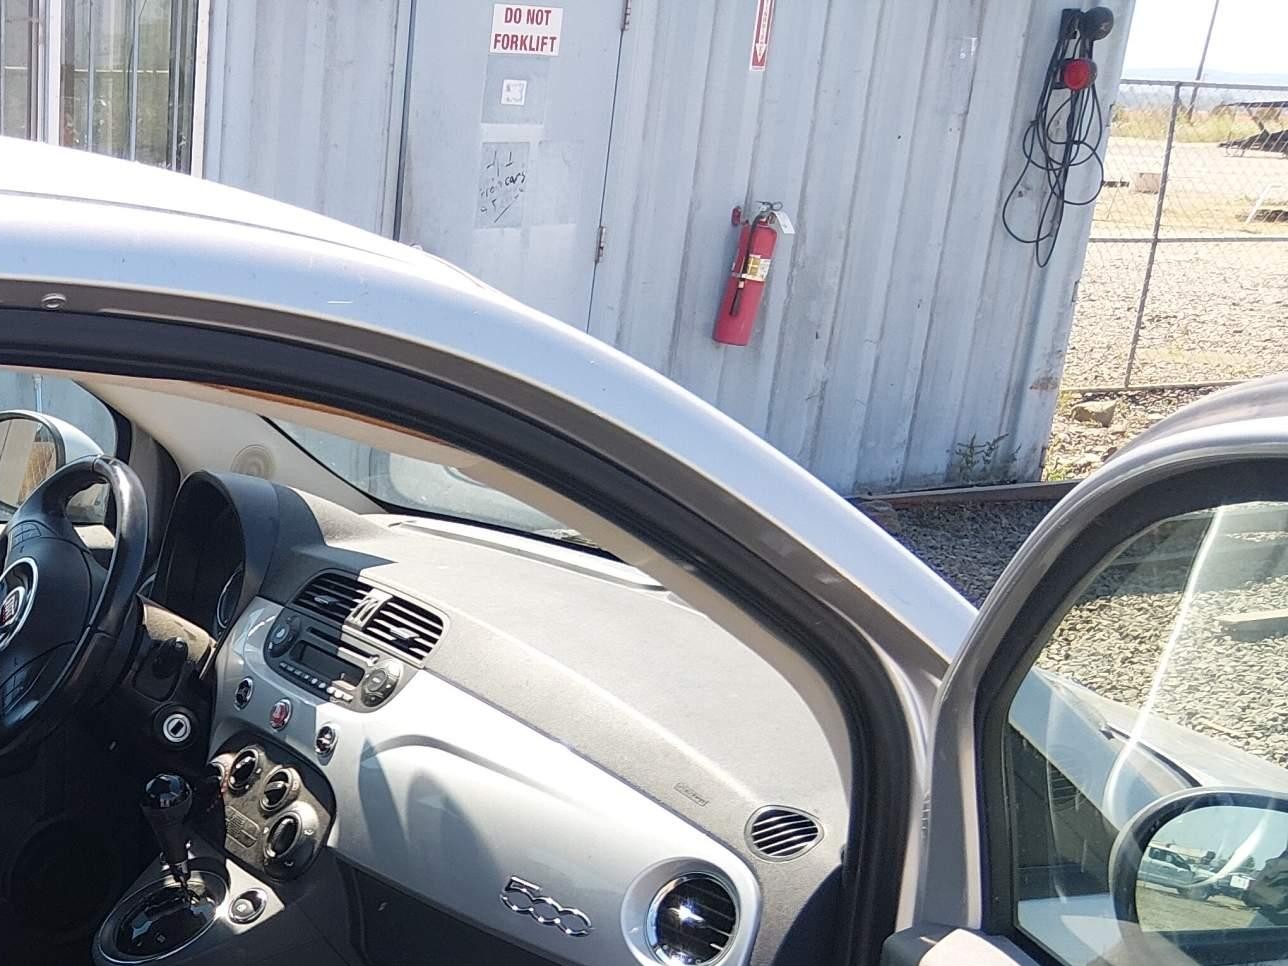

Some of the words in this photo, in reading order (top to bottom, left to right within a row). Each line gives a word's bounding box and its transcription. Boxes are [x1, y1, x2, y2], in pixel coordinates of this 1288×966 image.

[504, 7, 522, 24] DO
[526, 8, 552, 26] NOT
[493, 33, 557, 53] FORKLIFT
[499, 876, 592, 936] 500
